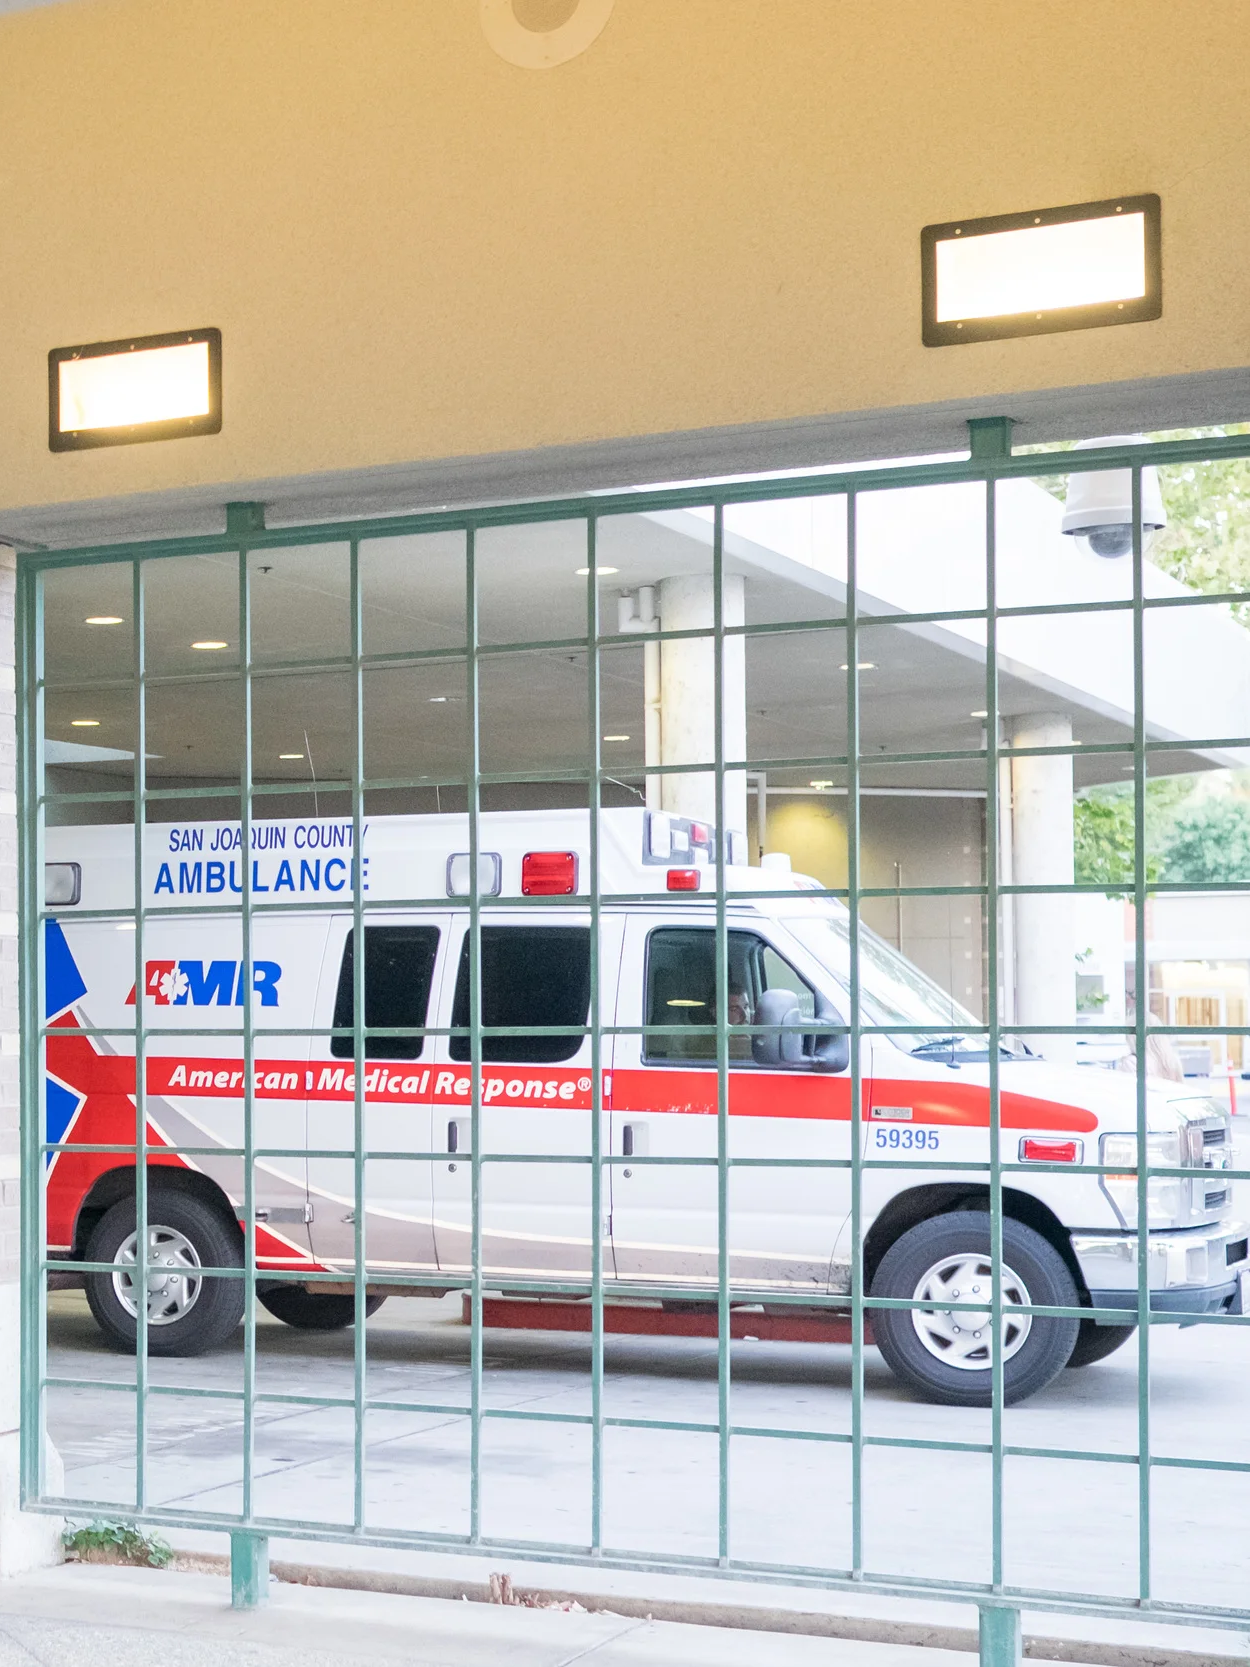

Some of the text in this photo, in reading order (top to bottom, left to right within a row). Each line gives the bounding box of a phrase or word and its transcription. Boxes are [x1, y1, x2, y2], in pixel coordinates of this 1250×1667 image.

[169, 828, 204, 852] SAN
[124, 960, 282, 1007] AMR
[317, 1067, 430, 1093] Medical
[876, 1128, 939, 1150] 59395
